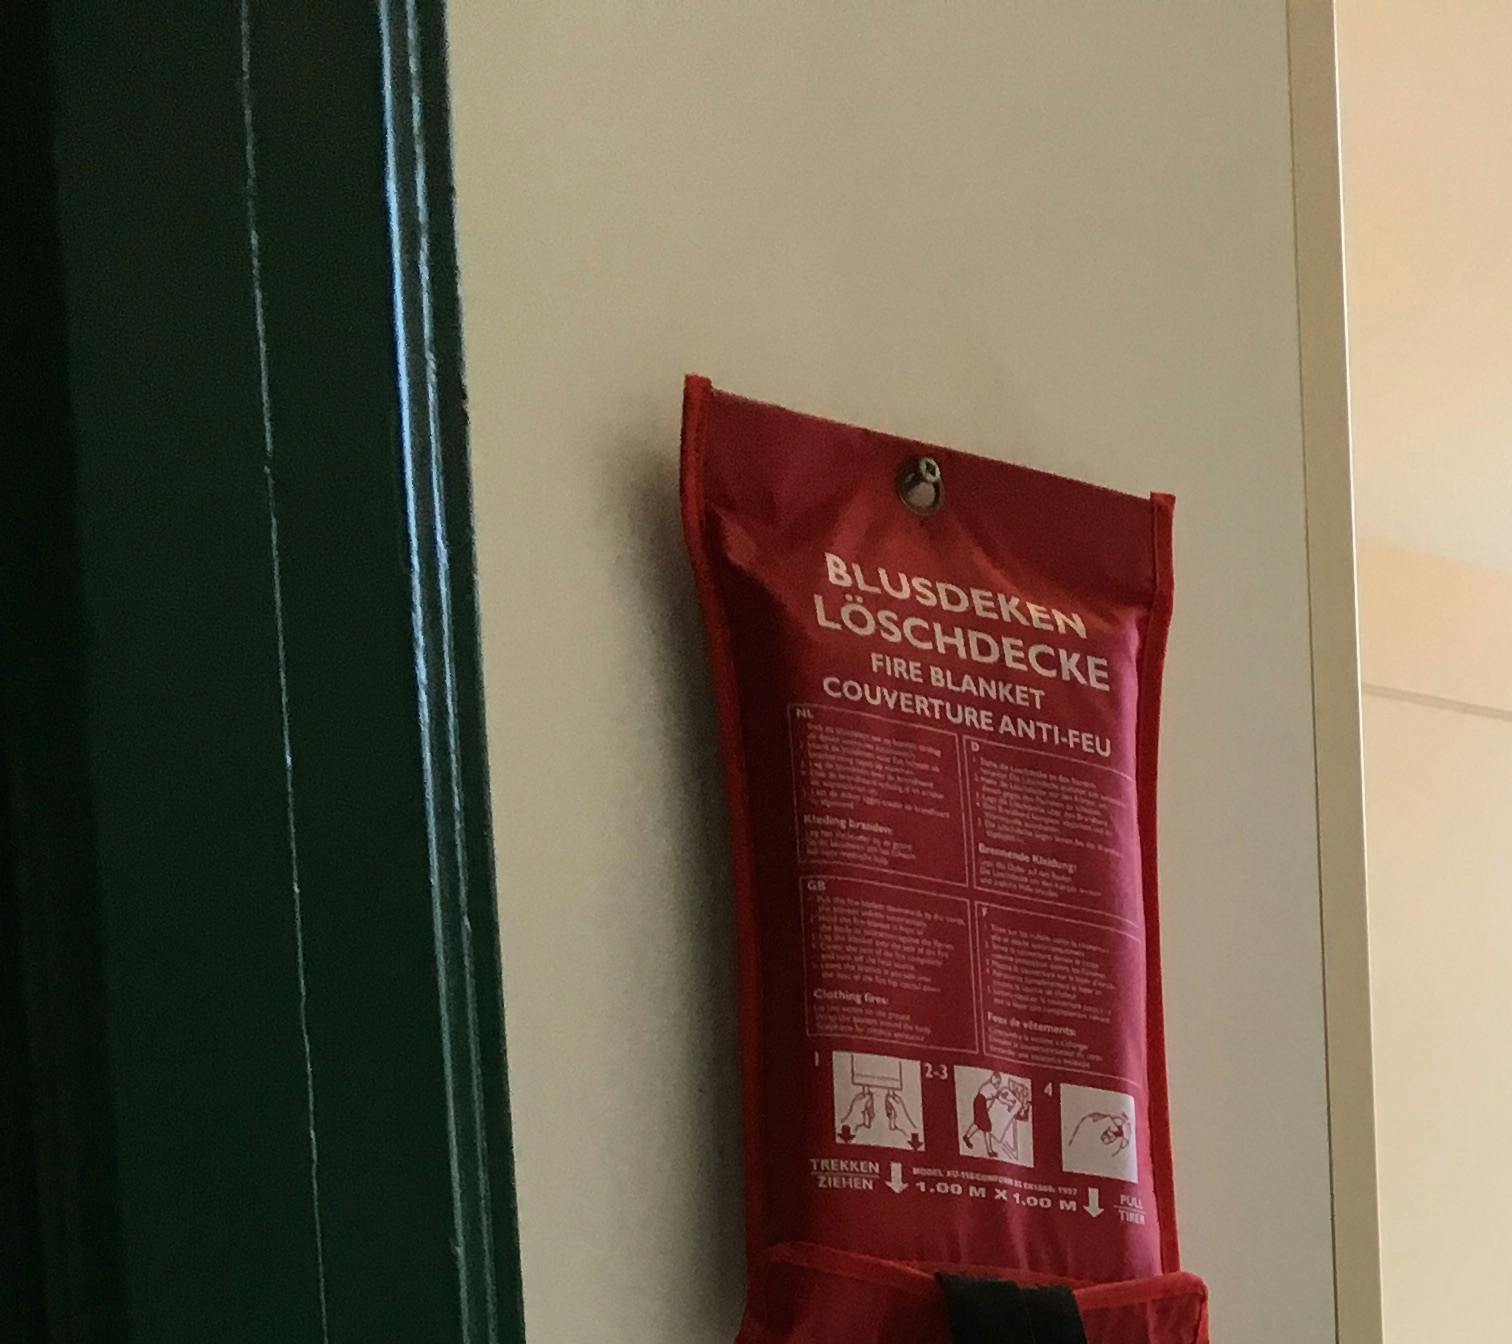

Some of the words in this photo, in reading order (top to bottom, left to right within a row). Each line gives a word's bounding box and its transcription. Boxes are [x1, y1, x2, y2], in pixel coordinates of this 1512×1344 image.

[825, 552, 1087, 639] BLUSDEKEN
[814, 593, 1110, 691] LÖSCHDECKE
[871, 652, 923, 682] FIRE
[929, 666, 1045, 709] BLANKET
[796, 708, 814, 719] NL
[823, 677, 994, 731] COUVERTURE
[998, 714, 1112, 757] ANTI-FEU
[971, 741, 980, 752] D
[807, 880, 827, 891] GB
[813, 988, 862, 1004] Clothing
[924, 1062, 949, 1080] 2-3
[1043, 1082, 1054, 1097] 4
[809, 1157, 880, 1174] TREKKEN
[817, 1175, 875, 1191] ZIEHEN
[916, 1180, 963, 1195] 1.00
[968, 1185, 987, 1199] M
[1013, 1192, 1053, 1209] 1.00
[1059, 1199, 1078, 1212] M
[1120, 1194, 1144, 1210] PULL
